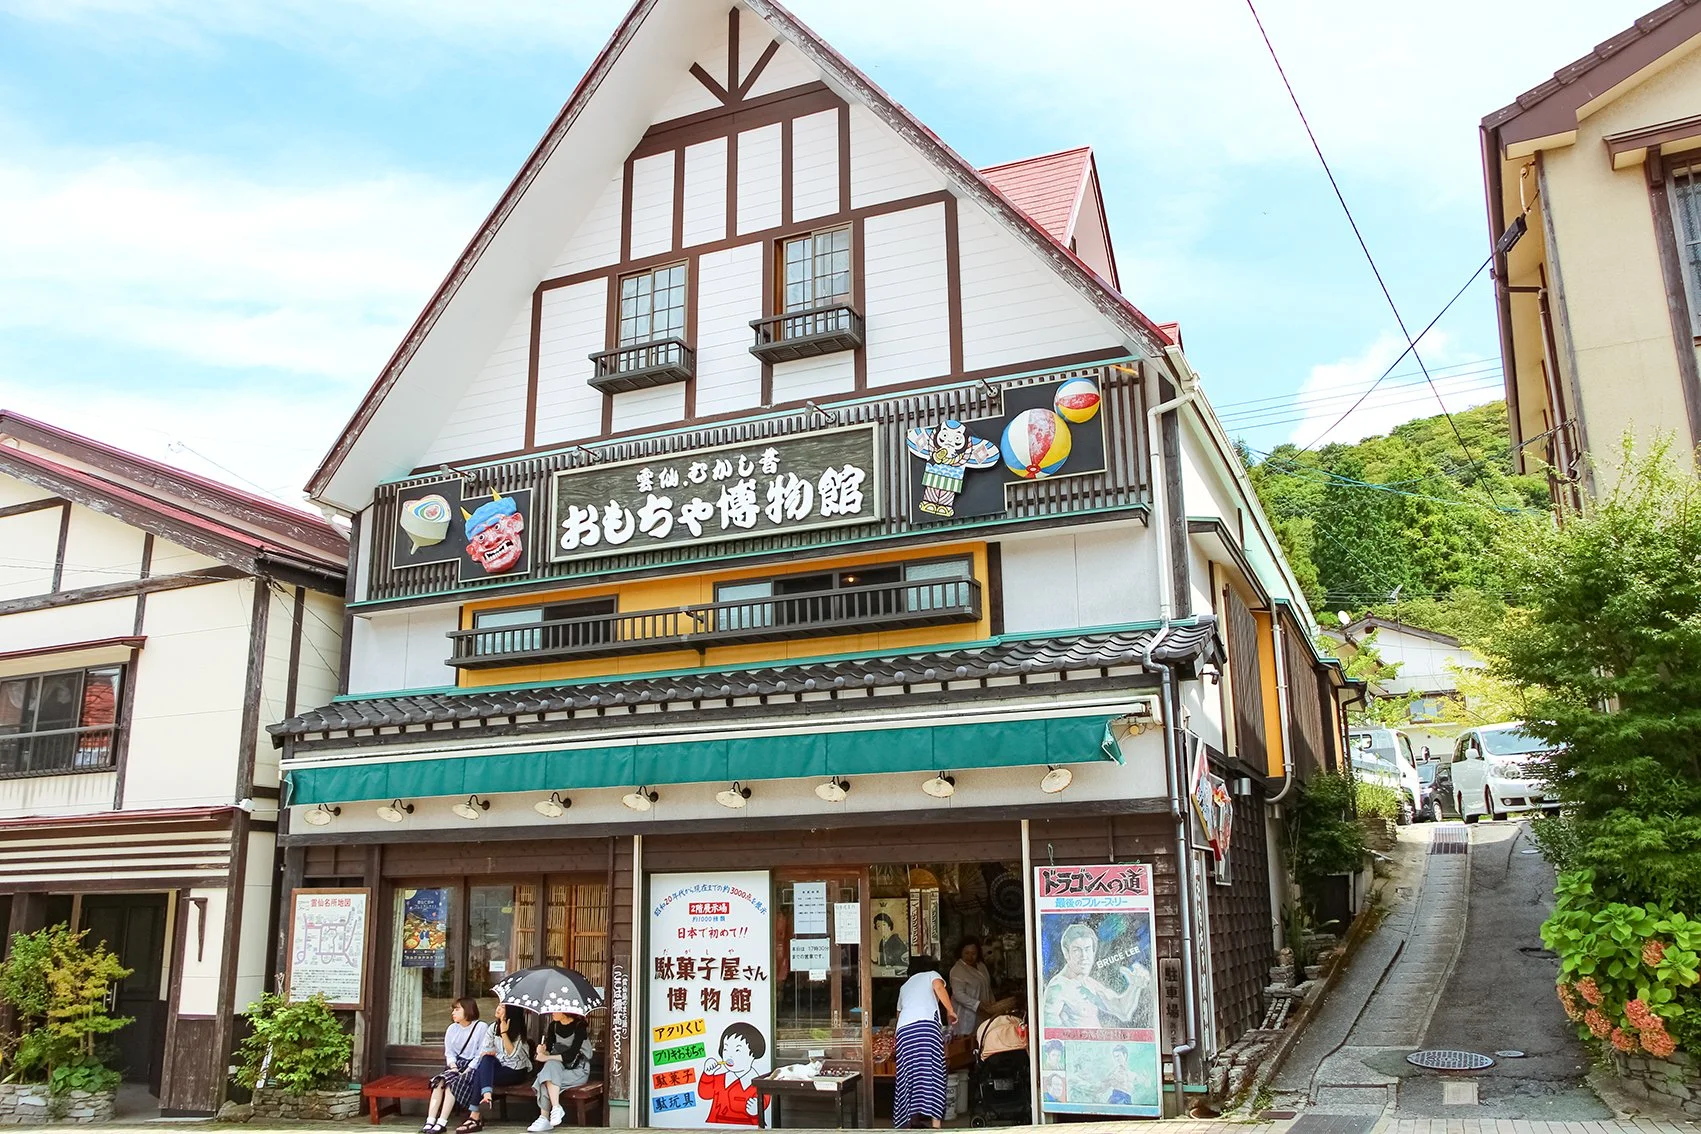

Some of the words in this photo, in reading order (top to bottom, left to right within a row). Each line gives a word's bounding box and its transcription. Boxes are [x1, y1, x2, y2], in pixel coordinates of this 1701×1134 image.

[560, 463, 866, 550] おもちゃ博物館
[1042, 868, 1145, 896] ドラゴンへの道
[654, 956, 768, 981] 駄菓子屋さん
[1096, 951, 1126, 969] BRUCE
[1124, 945, 1141, 958] LEE
[667, 987, 752, 1013] 博物館
[655, 1046, 705, 1063] ブリキおもちゃ
[656, 1069, 693, 1089] 駄菓子
[656, 1092, 694, 1111] 駄玩具
